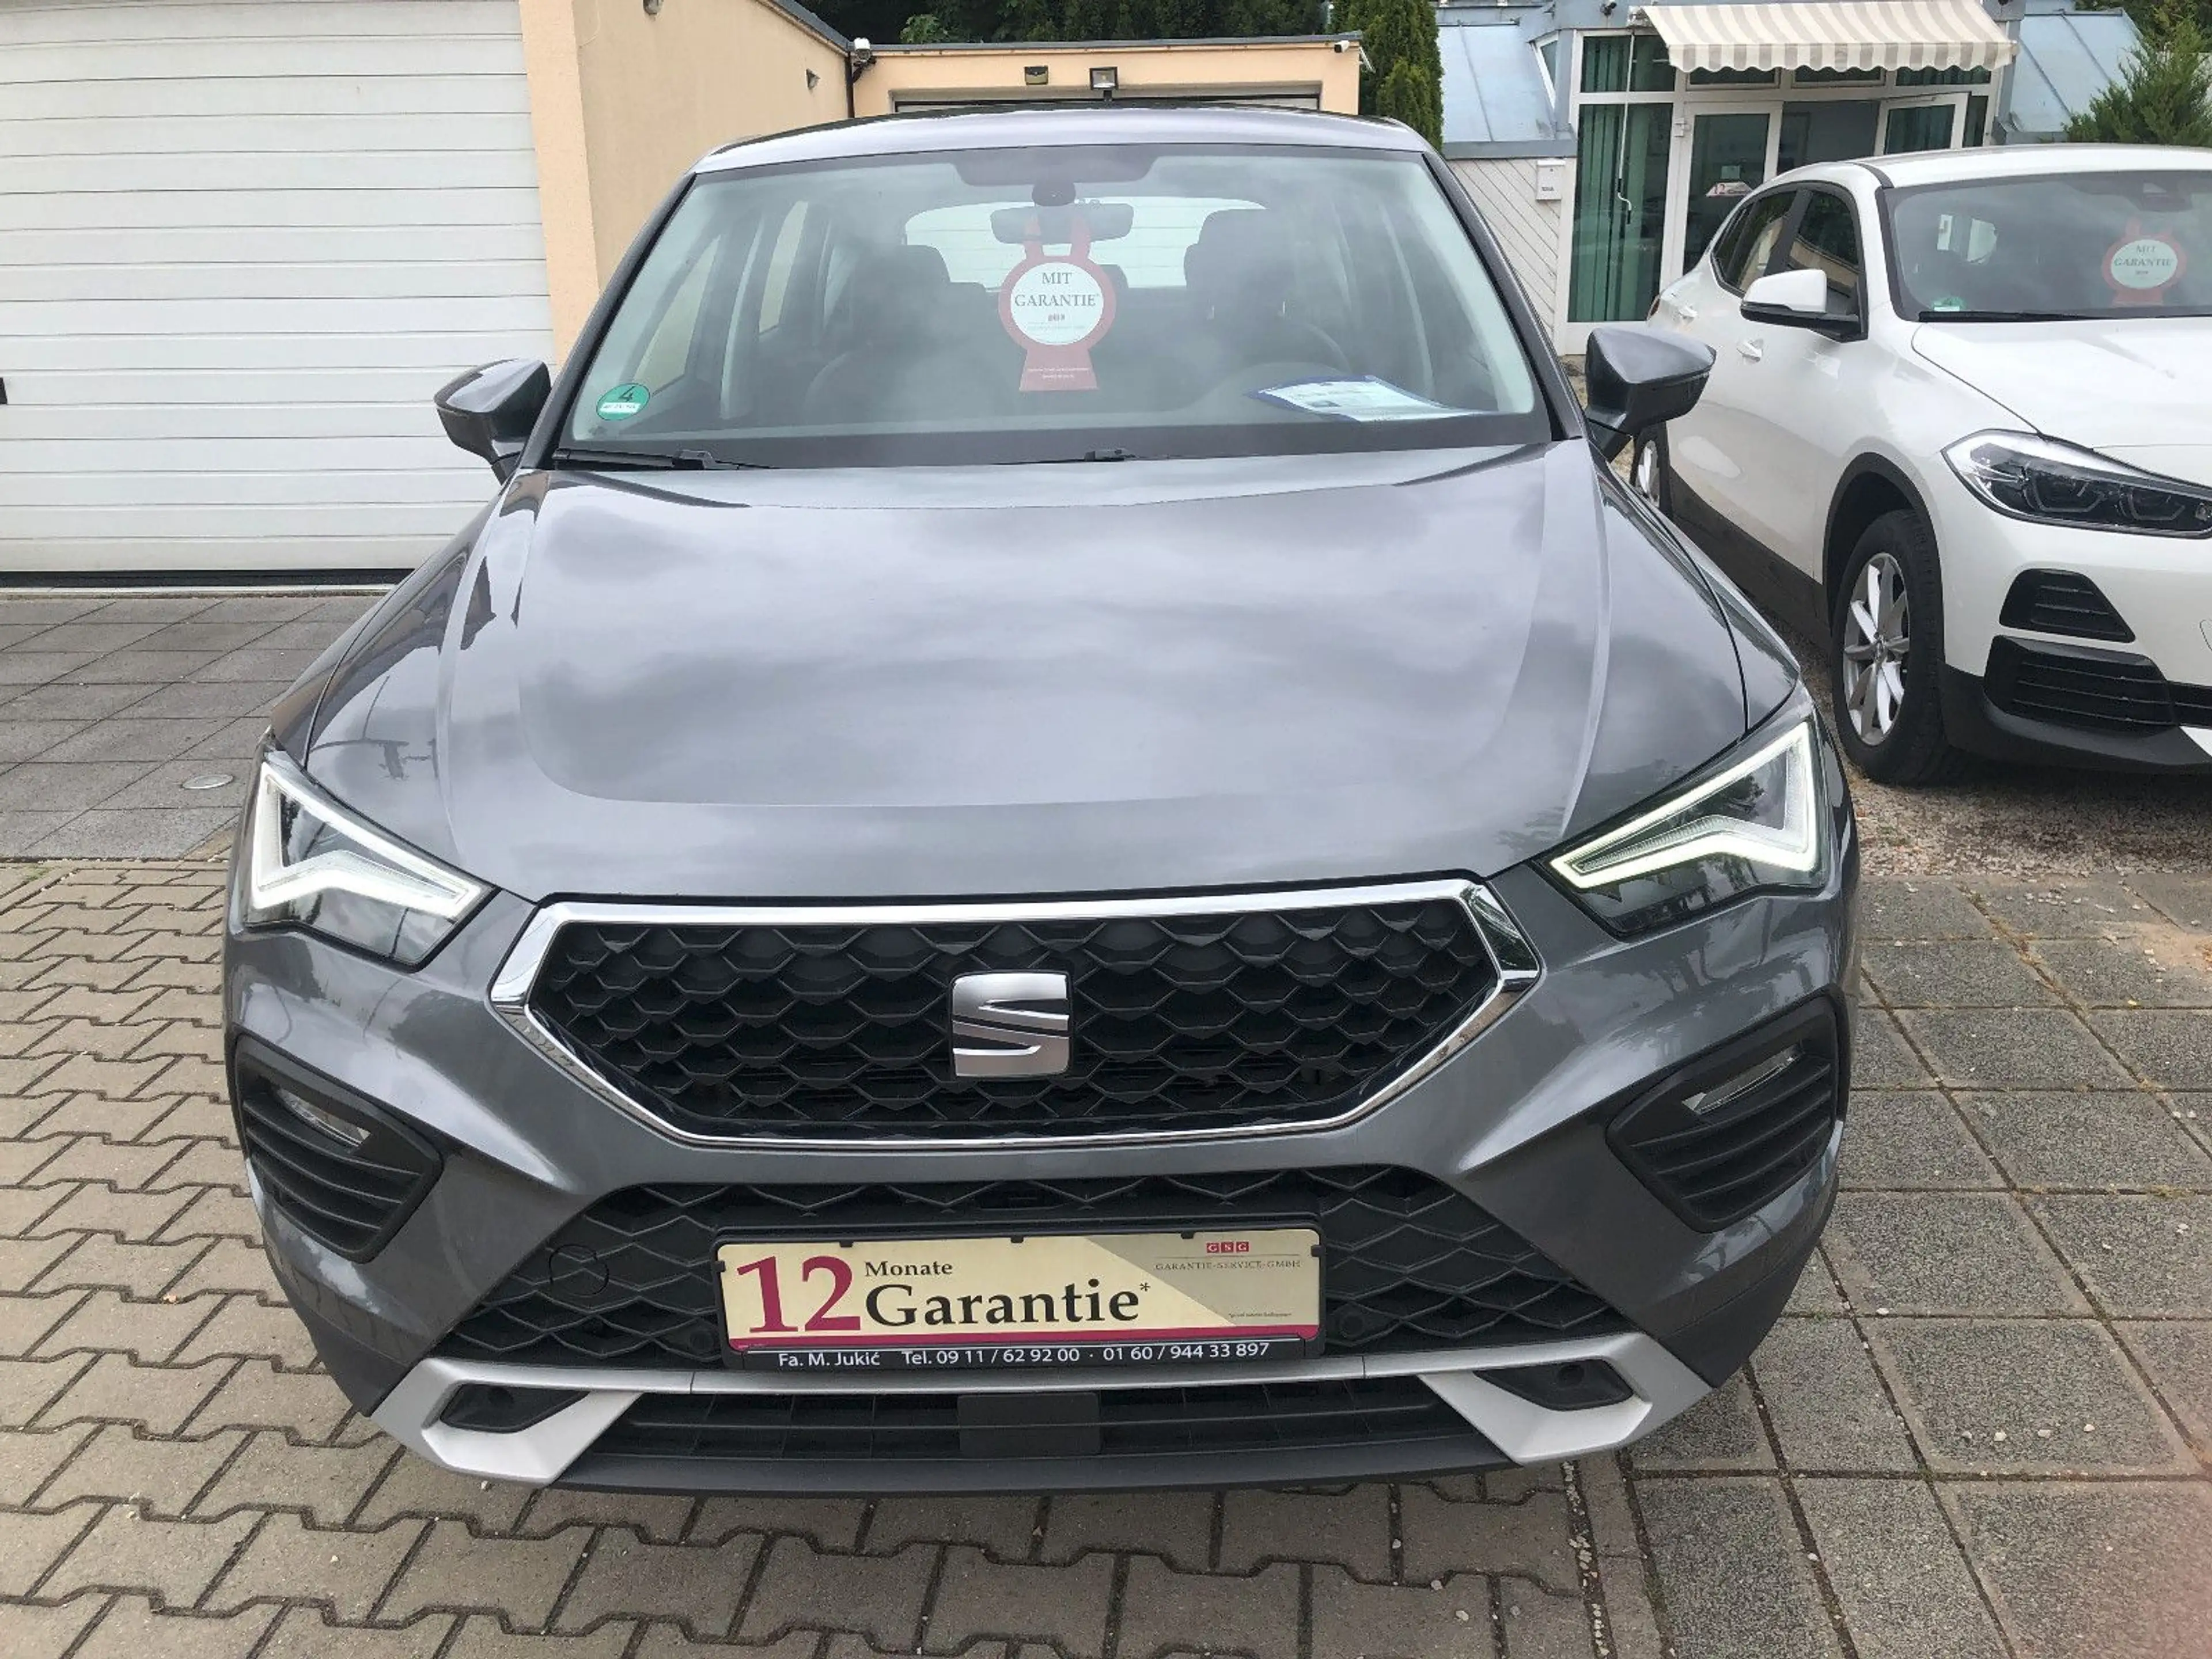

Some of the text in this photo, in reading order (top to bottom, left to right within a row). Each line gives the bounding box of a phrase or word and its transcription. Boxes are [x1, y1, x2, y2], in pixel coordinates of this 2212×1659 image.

[1041, 272, 1073, 285] MIT
[618, 385, 636, 403] 4
[864, 1260, 953, 1277] Monate
[736, 1255, 862, 1332] 12
[778, 1353, 804, 1367] Fa.
[808, 1352, 831, 1366] M.
[834, 1350, 881, 1366] Jukić
[901, 1349, 932, 1365] Tel.
[1002, 1349, 1025, 1363] 62
[1029, 1349, 1052, 1363] 92
[1057, 1347, 1080, 1362] 00
[1103, 1347, 1124, 1361] 01
[1130, 1346, 1153, 1361] 60
[1170, 1344, 1204, 1359] 944
[1209, 1343, 1230, 1358] 33
[1236, 1342, 1270, 1357] 897
